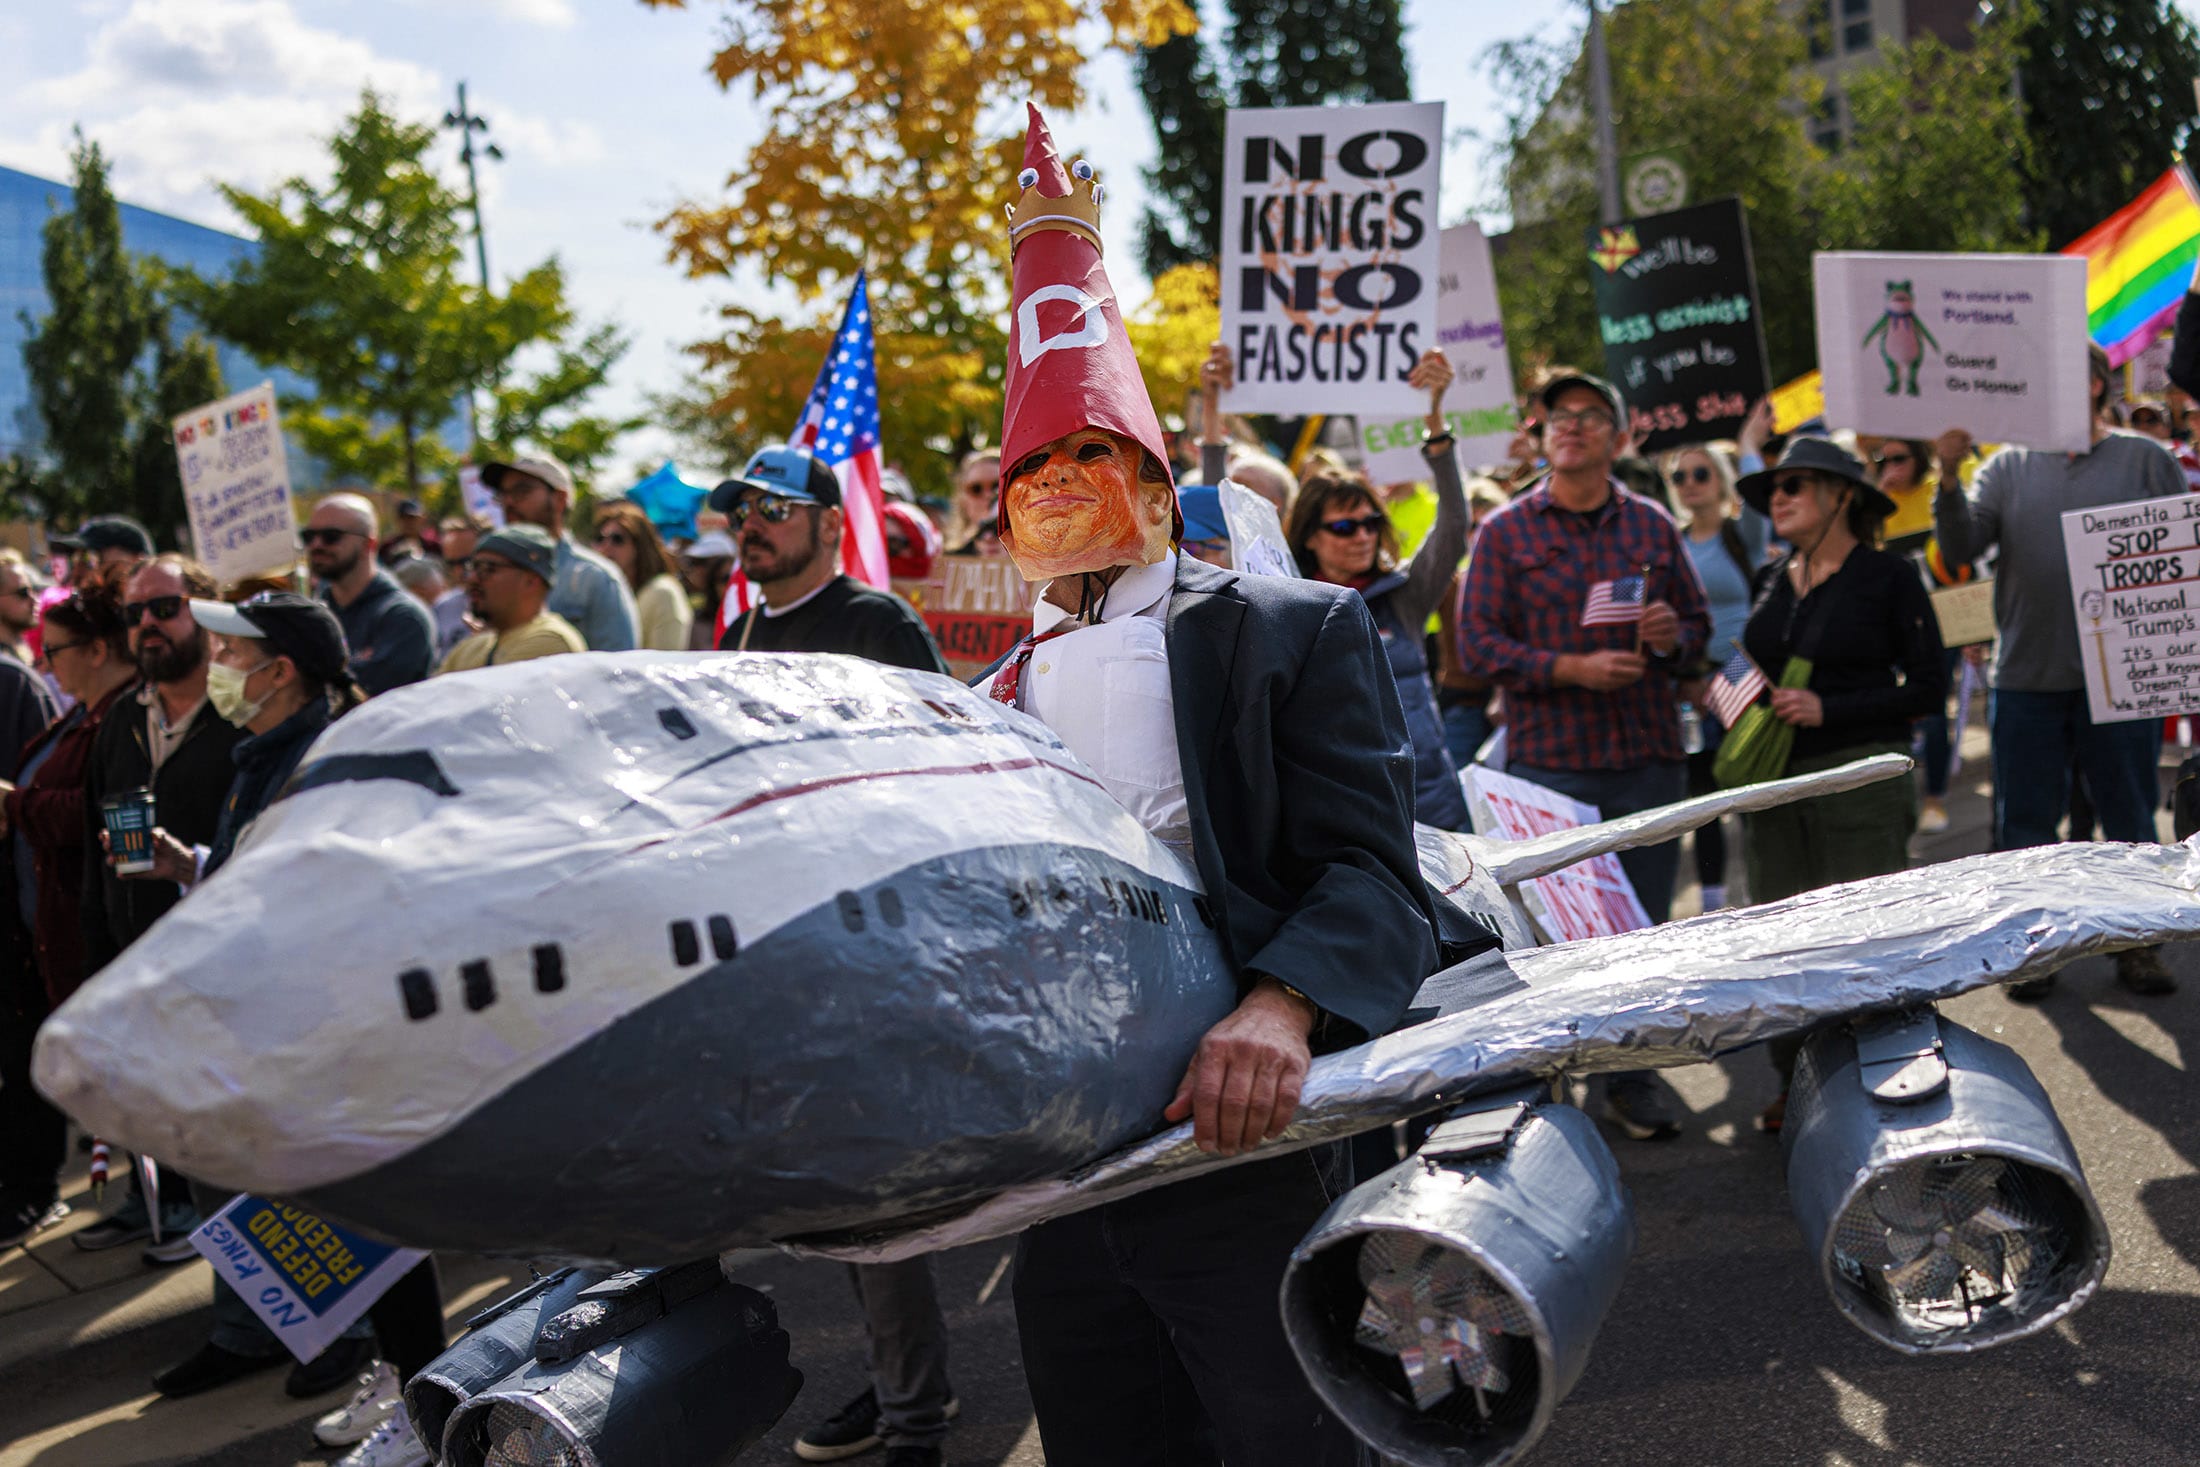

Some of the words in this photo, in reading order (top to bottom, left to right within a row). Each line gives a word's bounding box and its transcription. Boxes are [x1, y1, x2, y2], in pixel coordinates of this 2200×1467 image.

[1244, 130, 1428, 183] NO
[1242, 190, 1423, 253] KINGS
[1240, 263, 1422, 312] NO
[1238, 322, 1419, 383] FASCISTS
[1945, 353, 1996, 370] Guard
[1945, 376, 1970, 392] Go
[1364, 404, 1516, 453] EVERTHING
[2082, 506, 2169, 534] Dementia
[2107, 527, 2169, 557] STOP
[2095, 556, 2184, 592] TROOPS
[2112, 588, 2186, 618] National
[2122, 613, 2196, 637] Trump's
[2123, 646, 2153, 663] It's
[2167, 642, 2197, 657] our
[2132, 675, 2189, 694] Dream?
[203, 1220, 264, 1281] KINGS
[248, 1208, 333, 1299] DEFEND
[271, 1200, 365, 1286] FREEDO
[259, 1286, 308, 1329] NO
